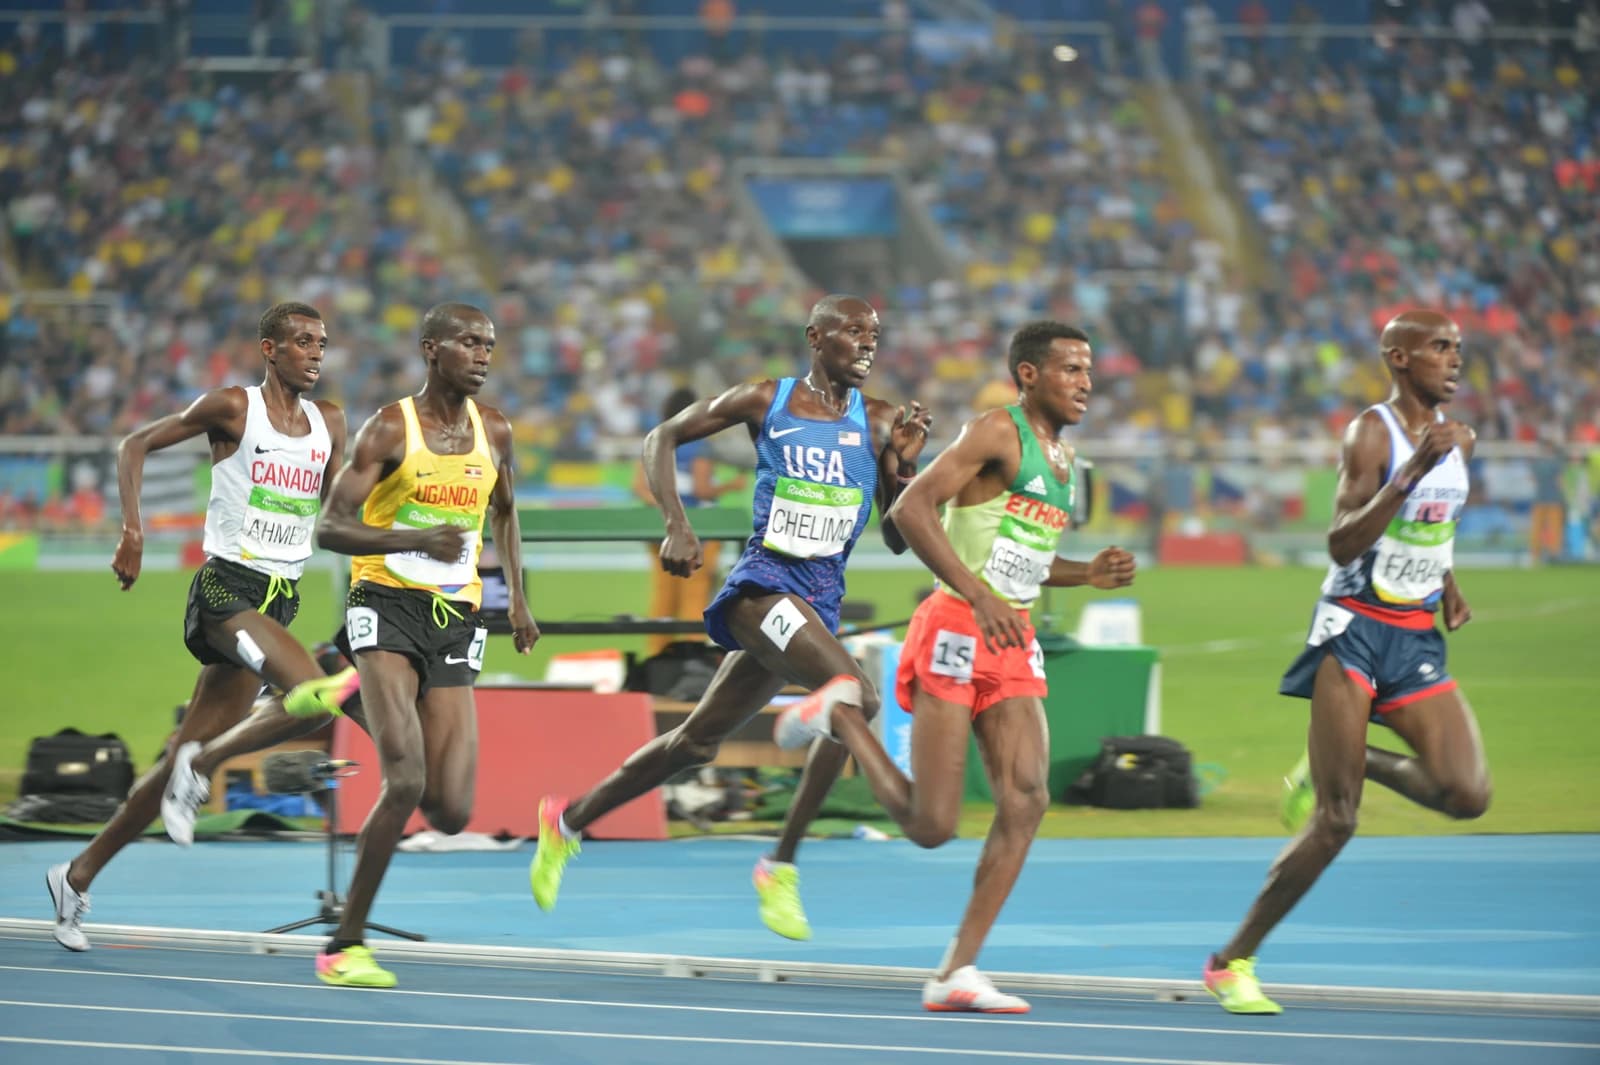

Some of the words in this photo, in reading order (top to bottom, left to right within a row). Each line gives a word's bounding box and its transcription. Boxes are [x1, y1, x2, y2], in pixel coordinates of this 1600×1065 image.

[251, 460, 321, 494] CANADA
[783, 445, 846, 486] USA
[415, 485, 478, 507] UGANDA
[247, 519, 309, 545] AHMED
[772, 508, 853, 542] CHELIMO
[349, 616, 373, 642] 13
[772, 614, 791, 636] 2
[935, 641, 970, 669] 15
